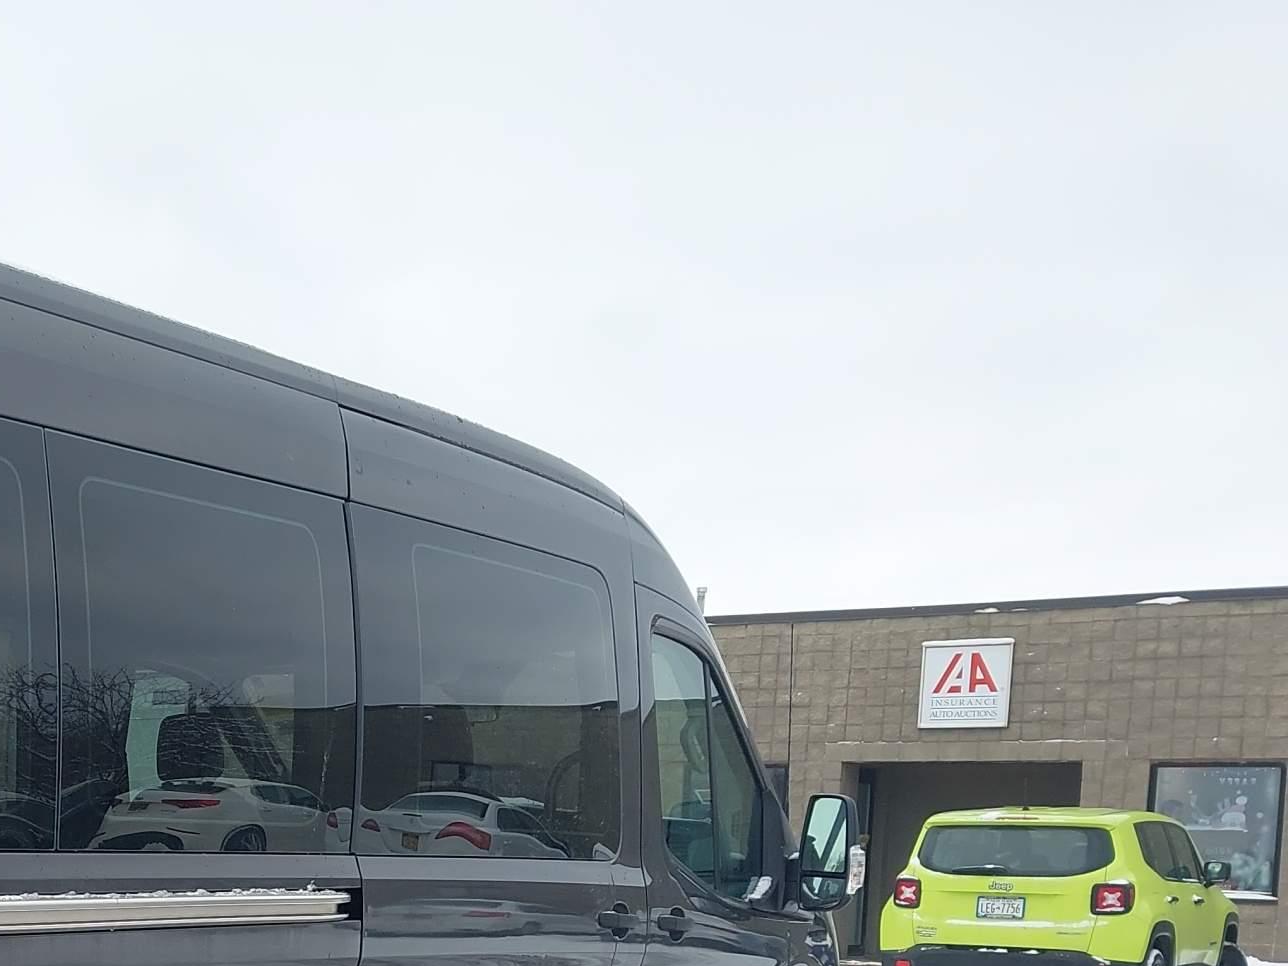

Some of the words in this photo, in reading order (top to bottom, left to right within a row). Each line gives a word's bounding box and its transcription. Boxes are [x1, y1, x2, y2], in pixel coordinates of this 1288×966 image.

[930, 698, 998, 708] INSURANCE
[929, 710, 953, 719] AUTO
[954, 710, 998, 719] AUCTIONS
[988, 880, 1014, 892] Jeep
